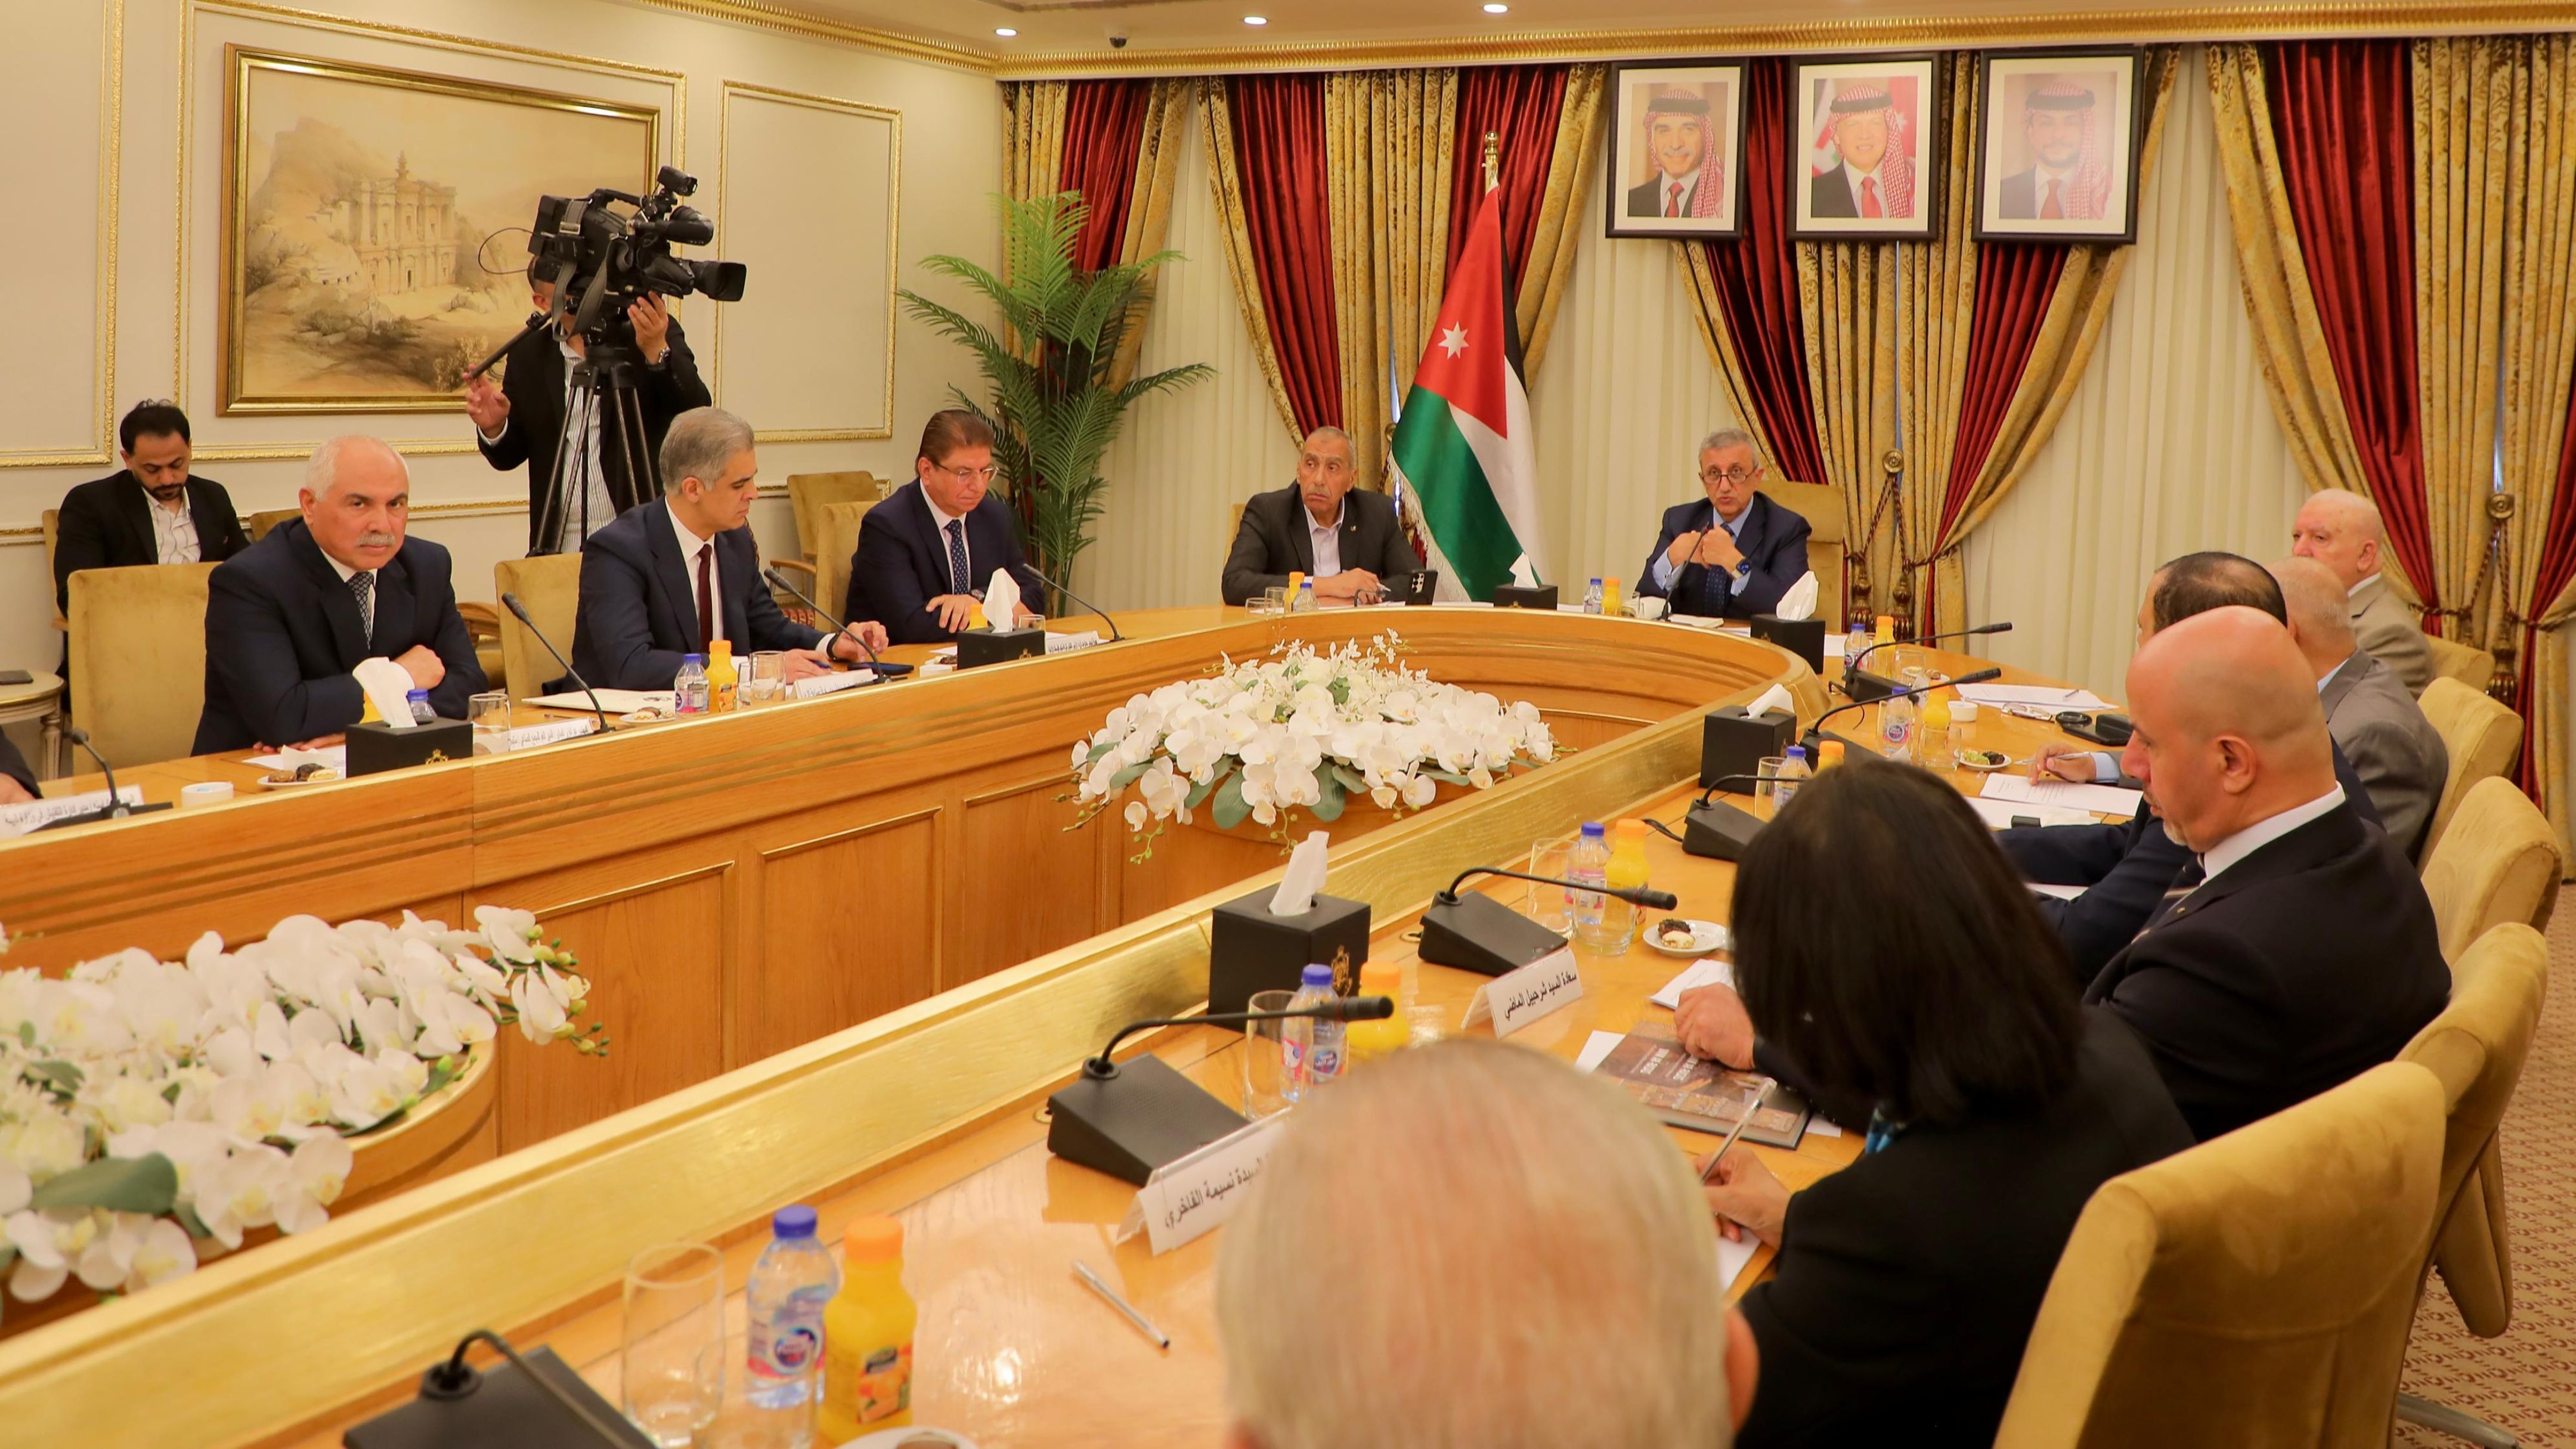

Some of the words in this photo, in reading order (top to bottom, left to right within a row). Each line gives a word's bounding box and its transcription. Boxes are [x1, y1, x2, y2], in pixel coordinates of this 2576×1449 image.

[1549, 974, 1561, 995] السيد
[1561, 970, 1577, 985] سعادة
[1205, 1171, 1235, 1200] نسيمة
